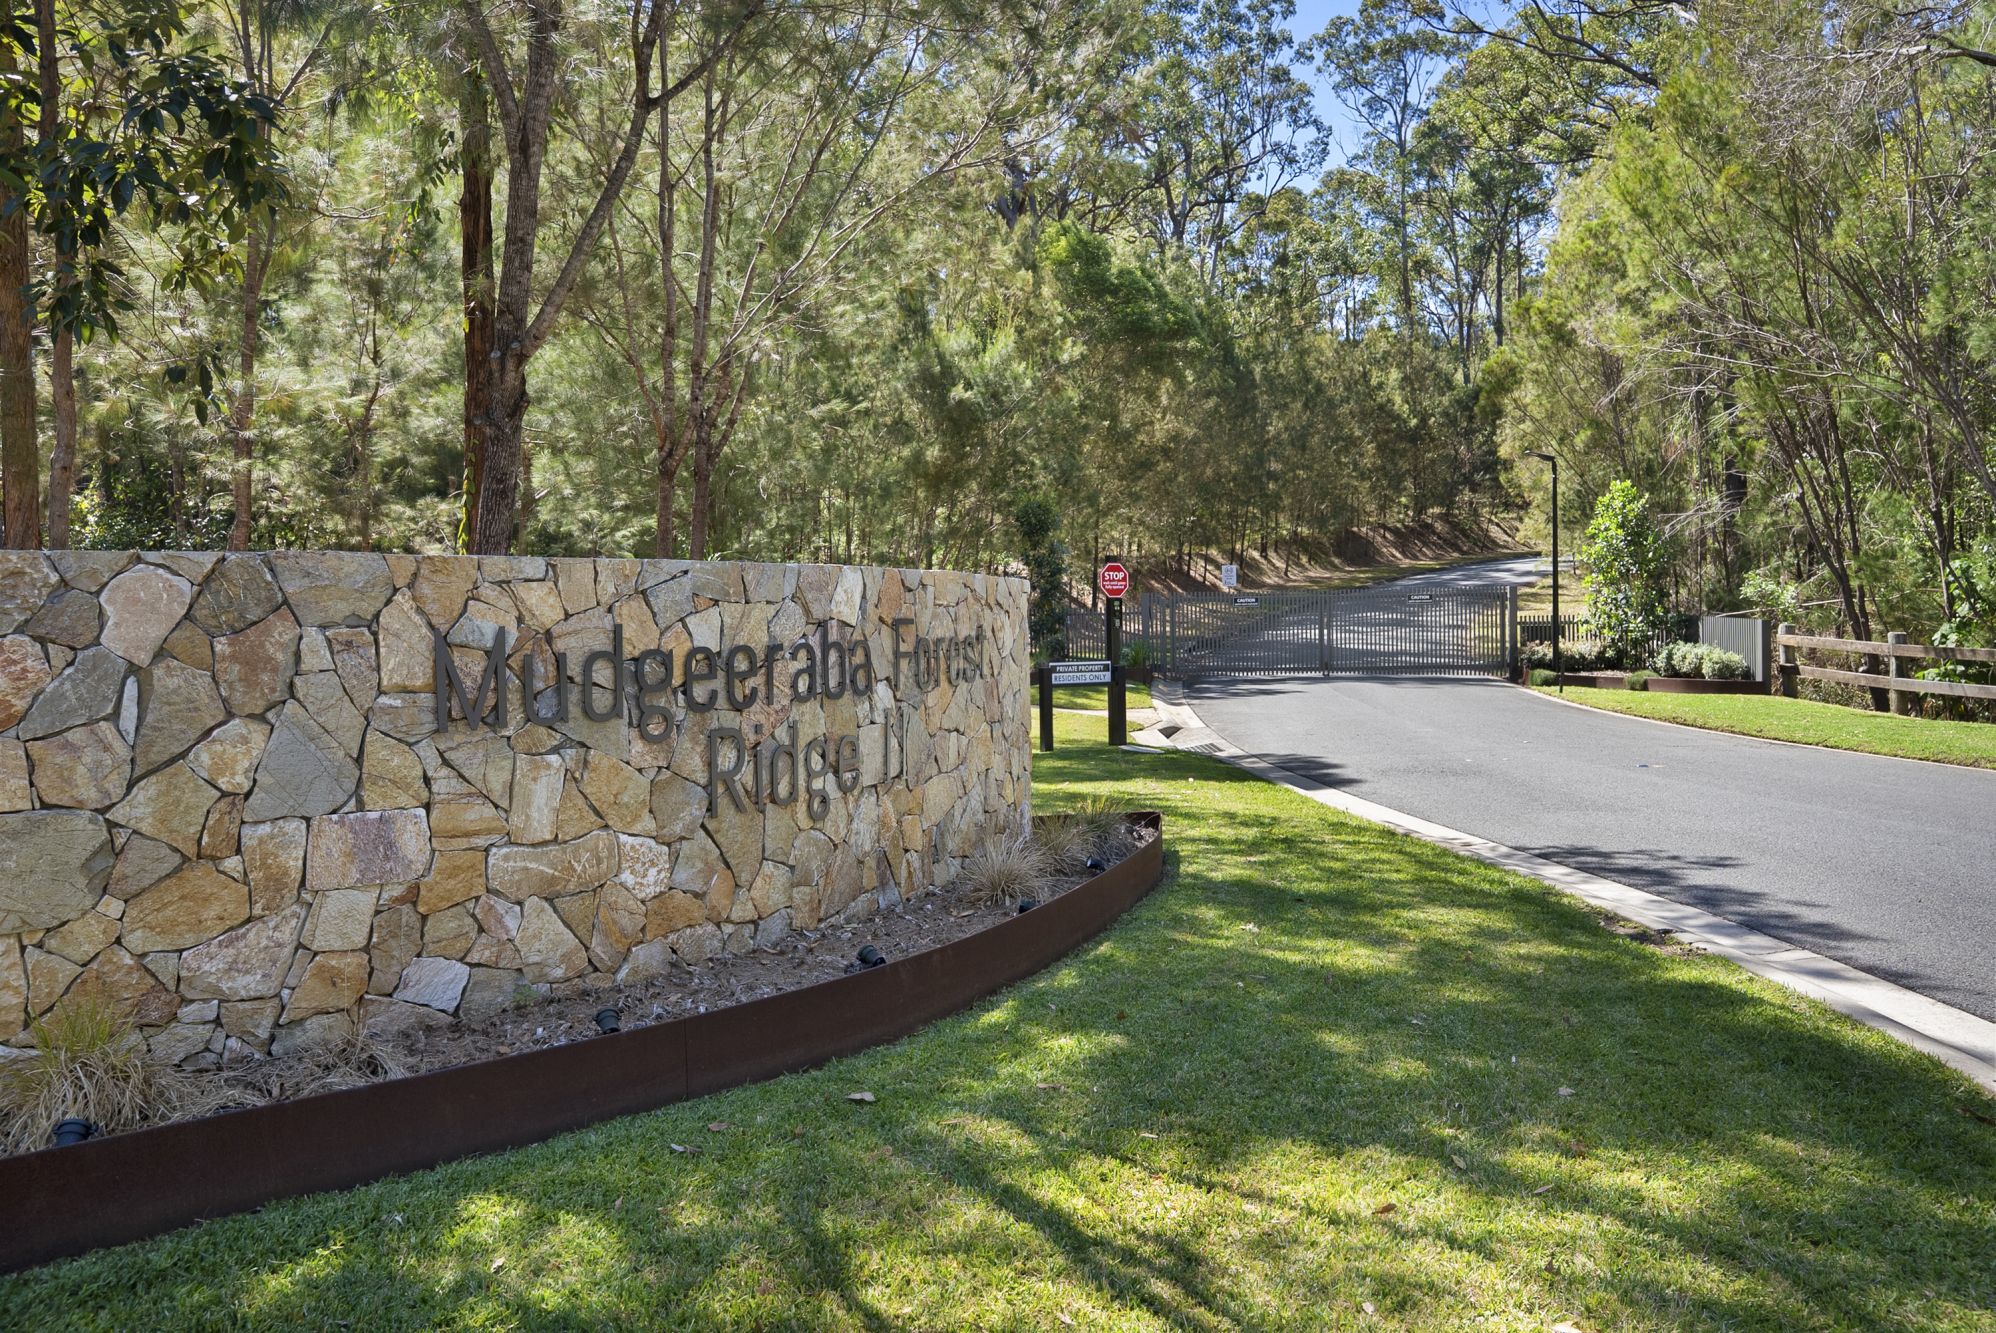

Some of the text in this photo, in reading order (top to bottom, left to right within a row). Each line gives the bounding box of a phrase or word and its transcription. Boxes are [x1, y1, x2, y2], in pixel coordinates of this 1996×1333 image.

[1104, 572, 1125, 580] STOP
[1078, 664, 1104, 672] PROPERTY
[433, 617, 988, 743] Mudgeeraba Forest
[1054, 673, 1107, 682] RESIDENTS ONLY
[708, 719, 860, 821] Ridge
